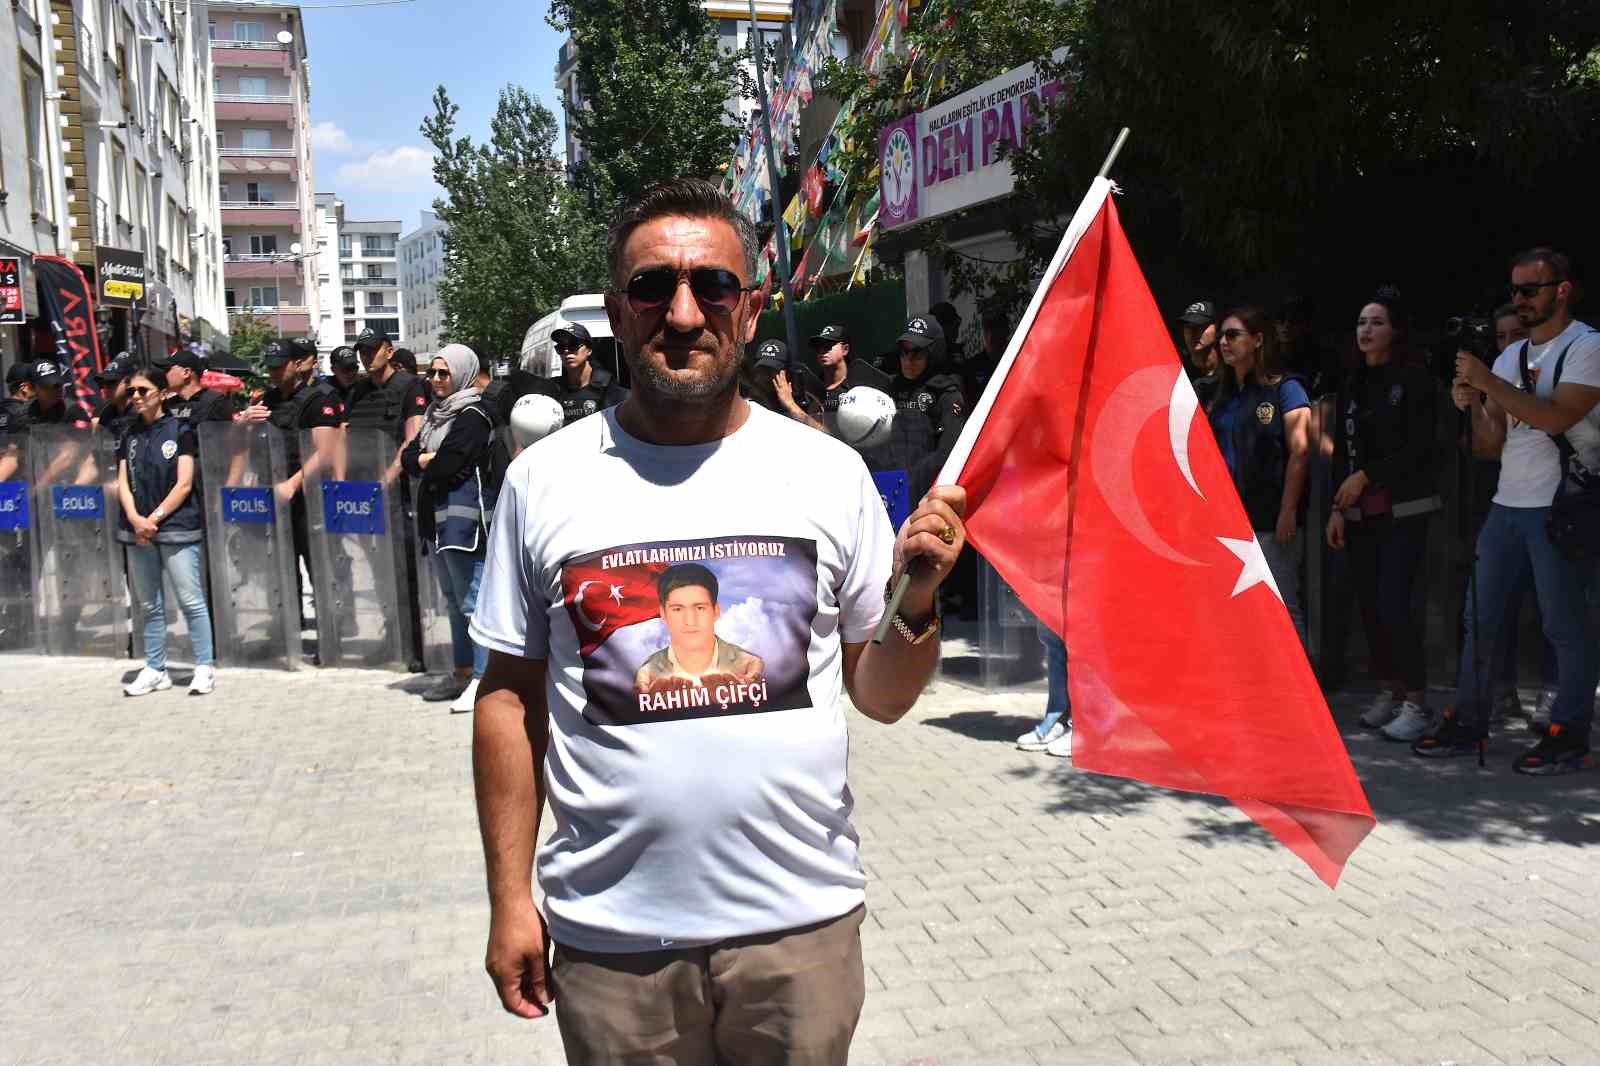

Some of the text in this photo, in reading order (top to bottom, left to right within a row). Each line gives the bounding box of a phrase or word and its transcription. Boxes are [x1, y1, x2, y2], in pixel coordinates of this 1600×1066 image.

[987, 93, 996, 109] VE
[996, 71, 1037, 103] DEMOKRASİ
[922, 117, 975, 187] DEM
[231, 497, 267, 513] POLİS
[602, 540, 786, 570] EVLATLARIMIZI İSTİYORUZ
[639, 678, 768, 712] RAHİM ÇİFÇİ
